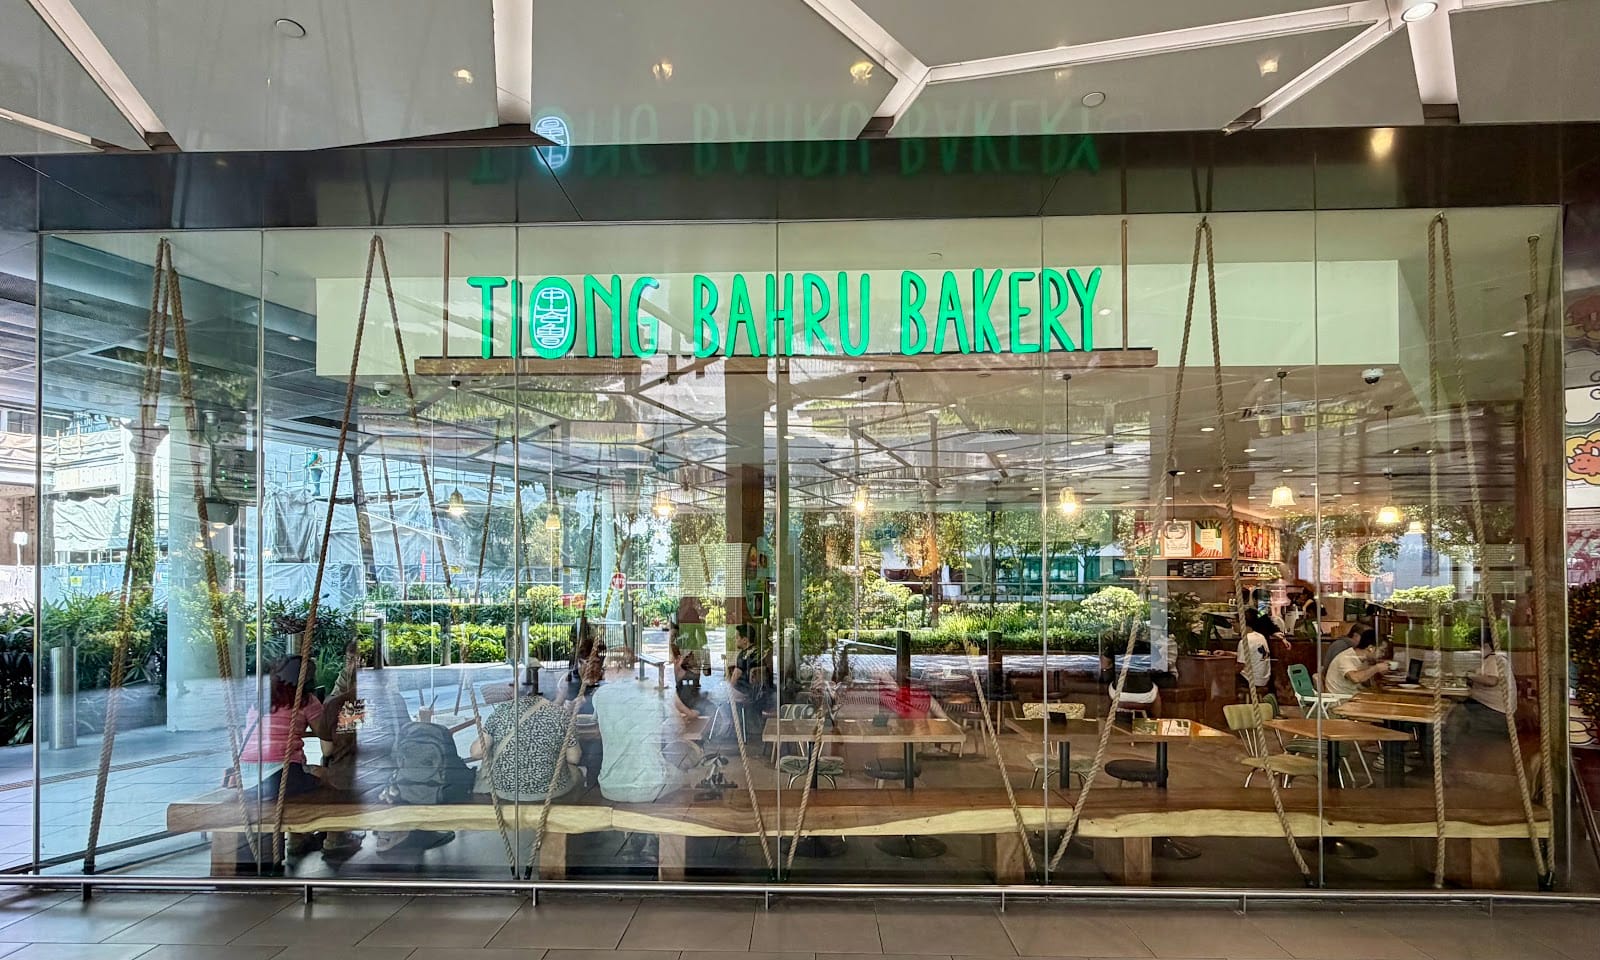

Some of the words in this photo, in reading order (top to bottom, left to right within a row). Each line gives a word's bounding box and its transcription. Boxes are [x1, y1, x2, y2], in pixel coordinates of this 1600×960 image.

[467, 274, 660, 359] TIONG
[693, 271, 871, 358] BAHRU
[900, 267, 1102, 356] BAKERY
